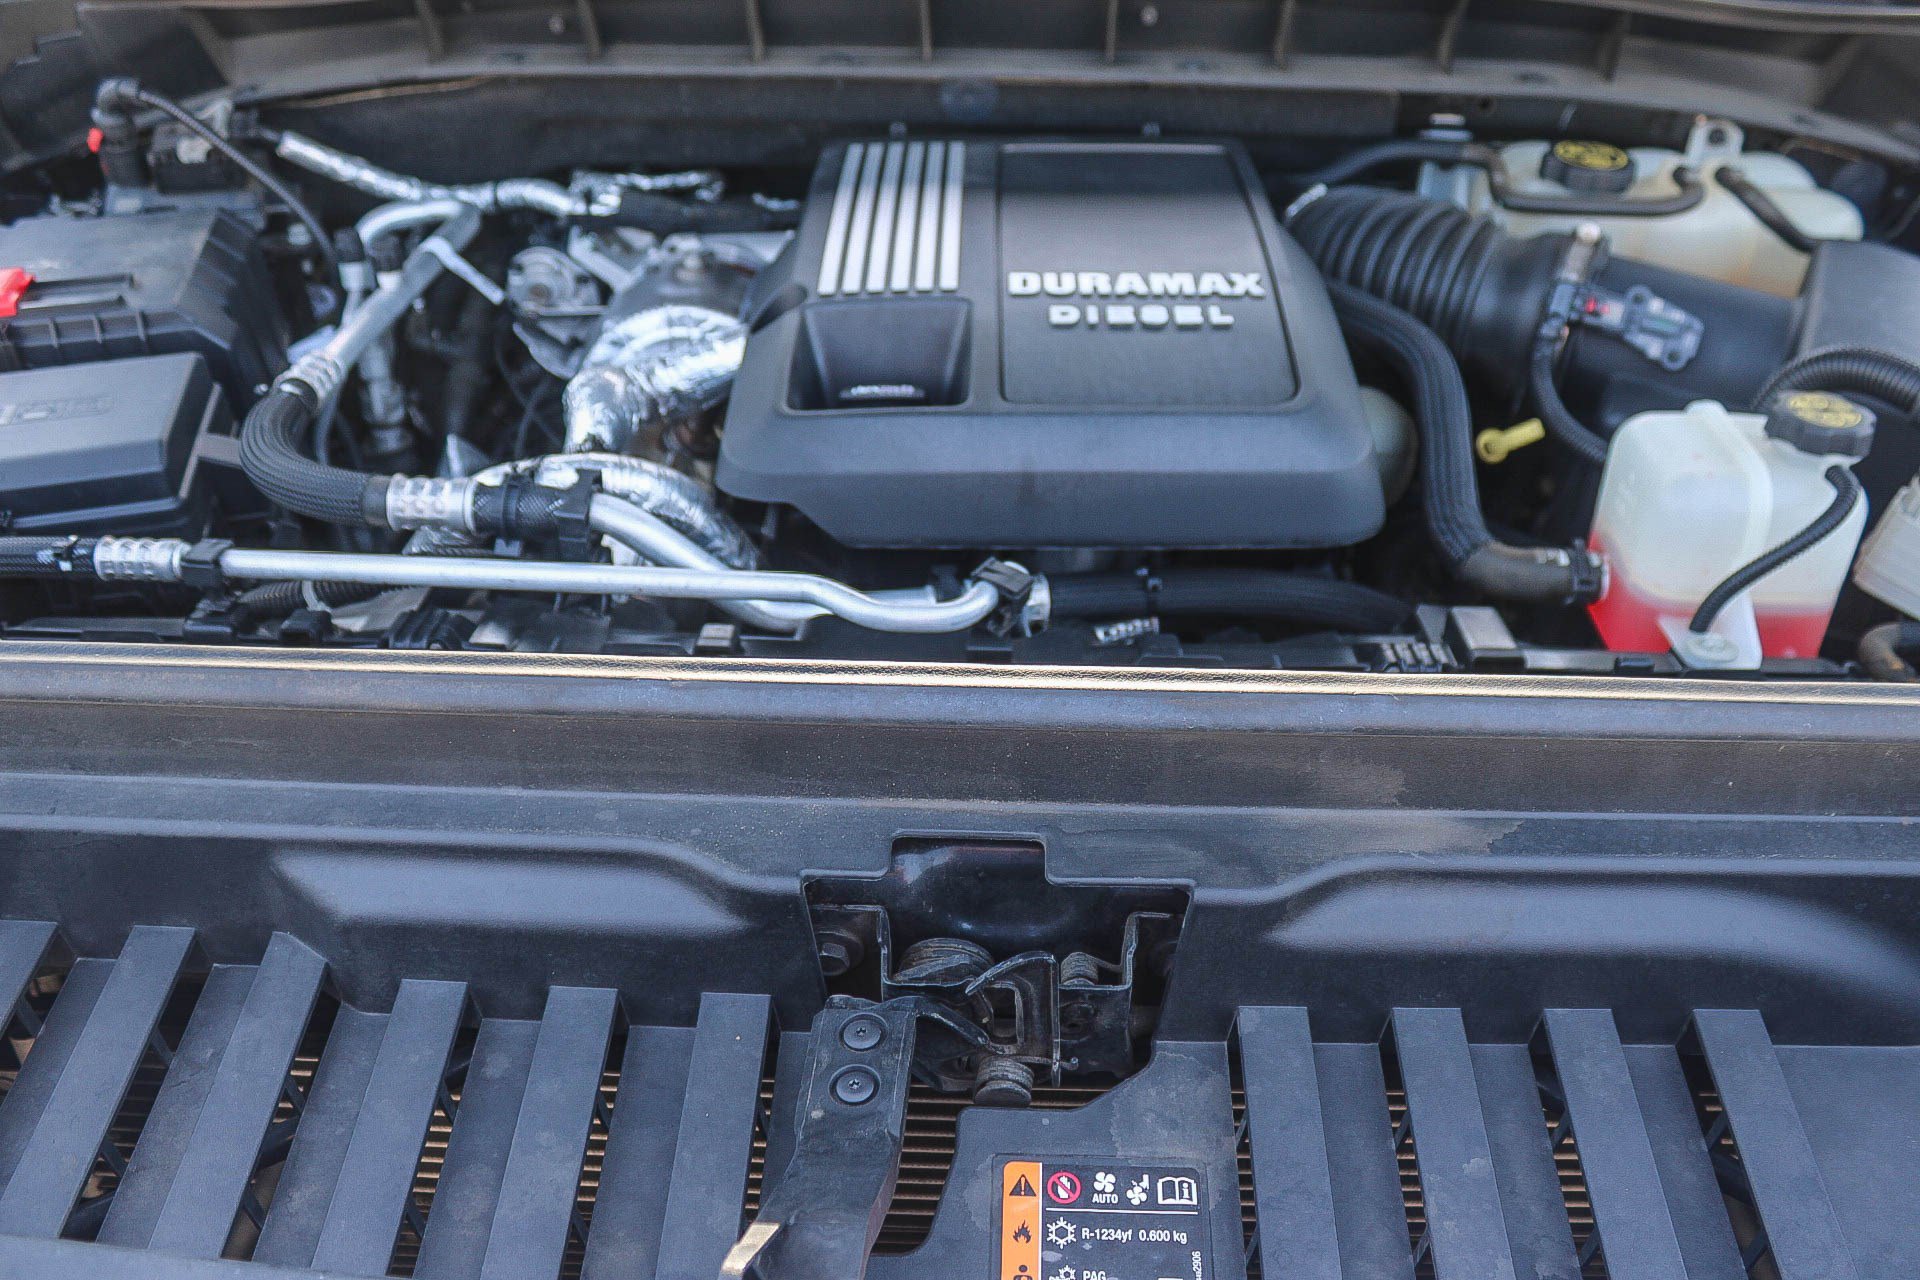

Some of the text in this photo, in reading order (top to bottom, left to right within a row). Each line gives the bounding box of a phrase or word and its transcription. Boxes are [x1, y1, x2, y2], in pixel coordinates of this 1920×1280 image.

[1007, 270, 1266, 298] DURAMAX
[1048, 304, 1235, 327] DIESEL
[1092, 1192, 1119, 1204] AUTO
[1081, 1227, 1188, 1245] R-1234yf 0.600 kg
[1082, 1270, 1107, 1280] PAG
